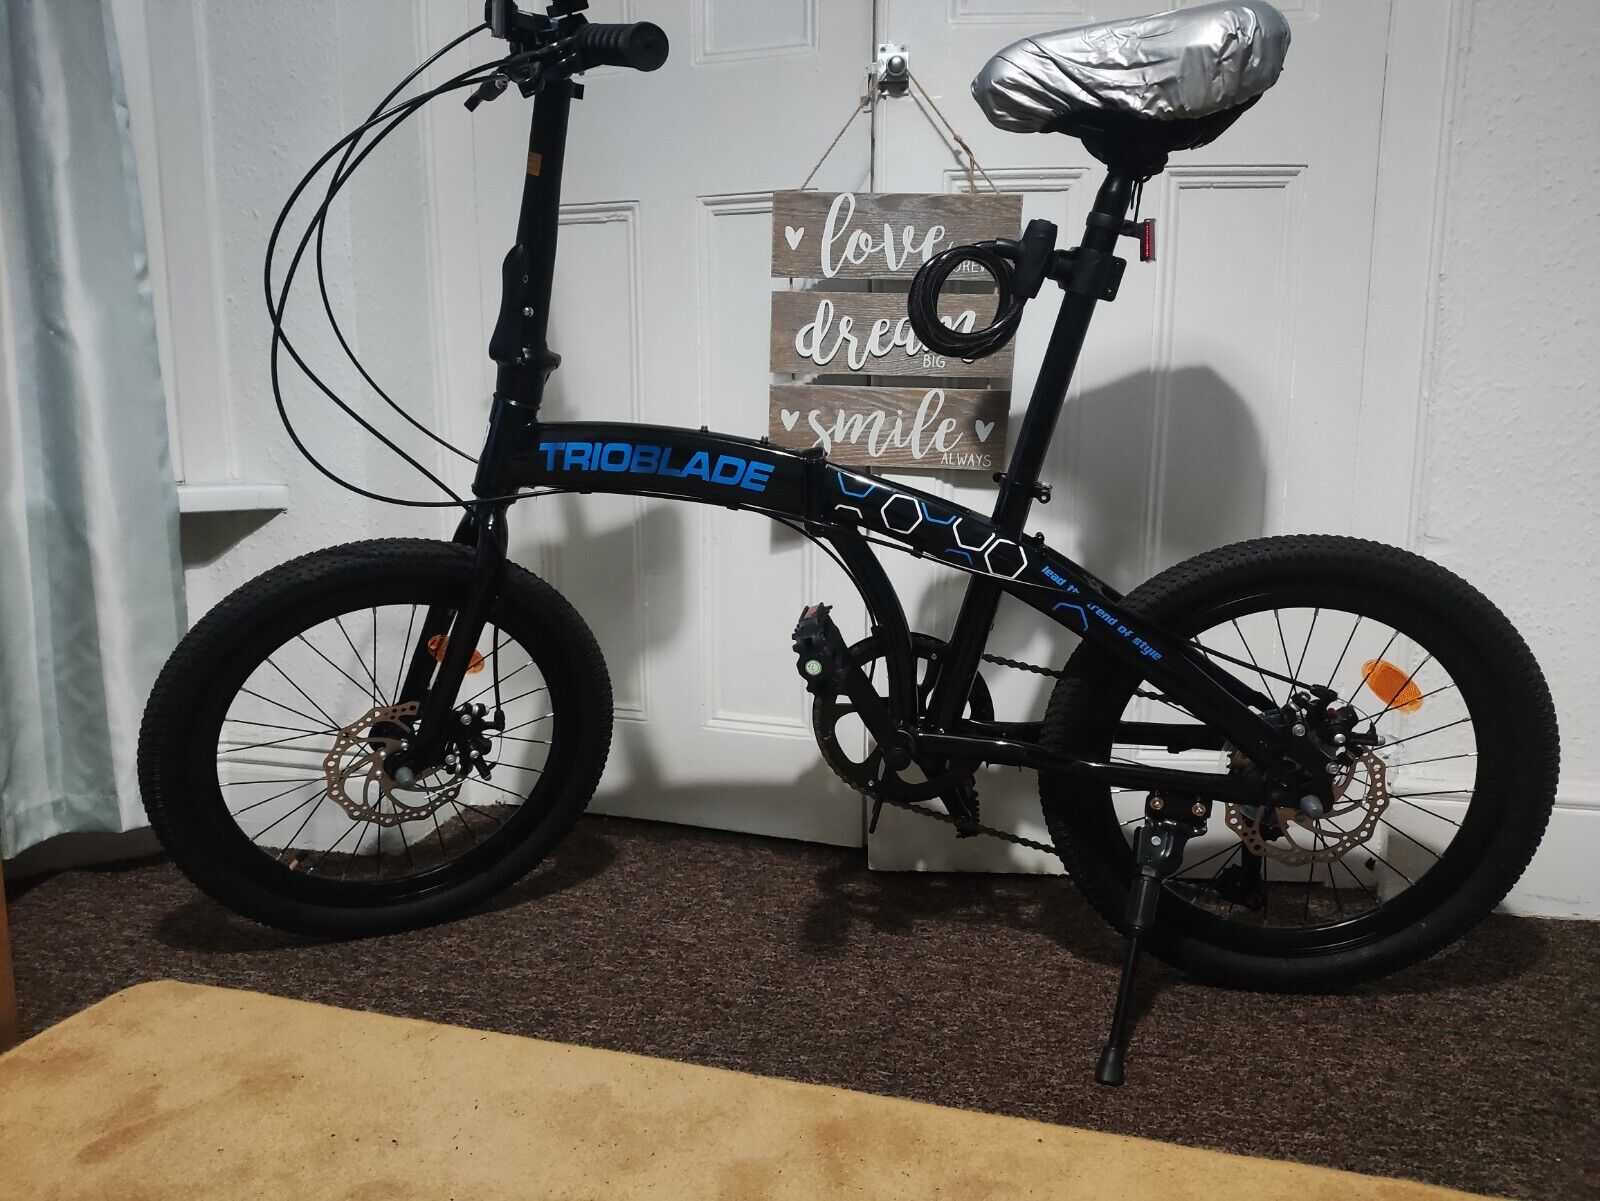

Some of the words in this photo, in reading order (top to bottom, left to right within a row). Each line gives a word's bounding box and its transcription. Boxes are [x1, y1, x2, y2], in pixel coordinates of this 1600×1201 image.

[821, 192, 954, 278] love
[923, 354, 946, 368] BIG
[808, 388, 963, 460] smile
[538, 441, 776, 493] TRIOBLADE
[940, 452, 992, 467] ALWAYS
[1041, 565, 1067, 587] lead
[1117, 624, 1134, 638] of
[1132, 636, 1163, 662] style
